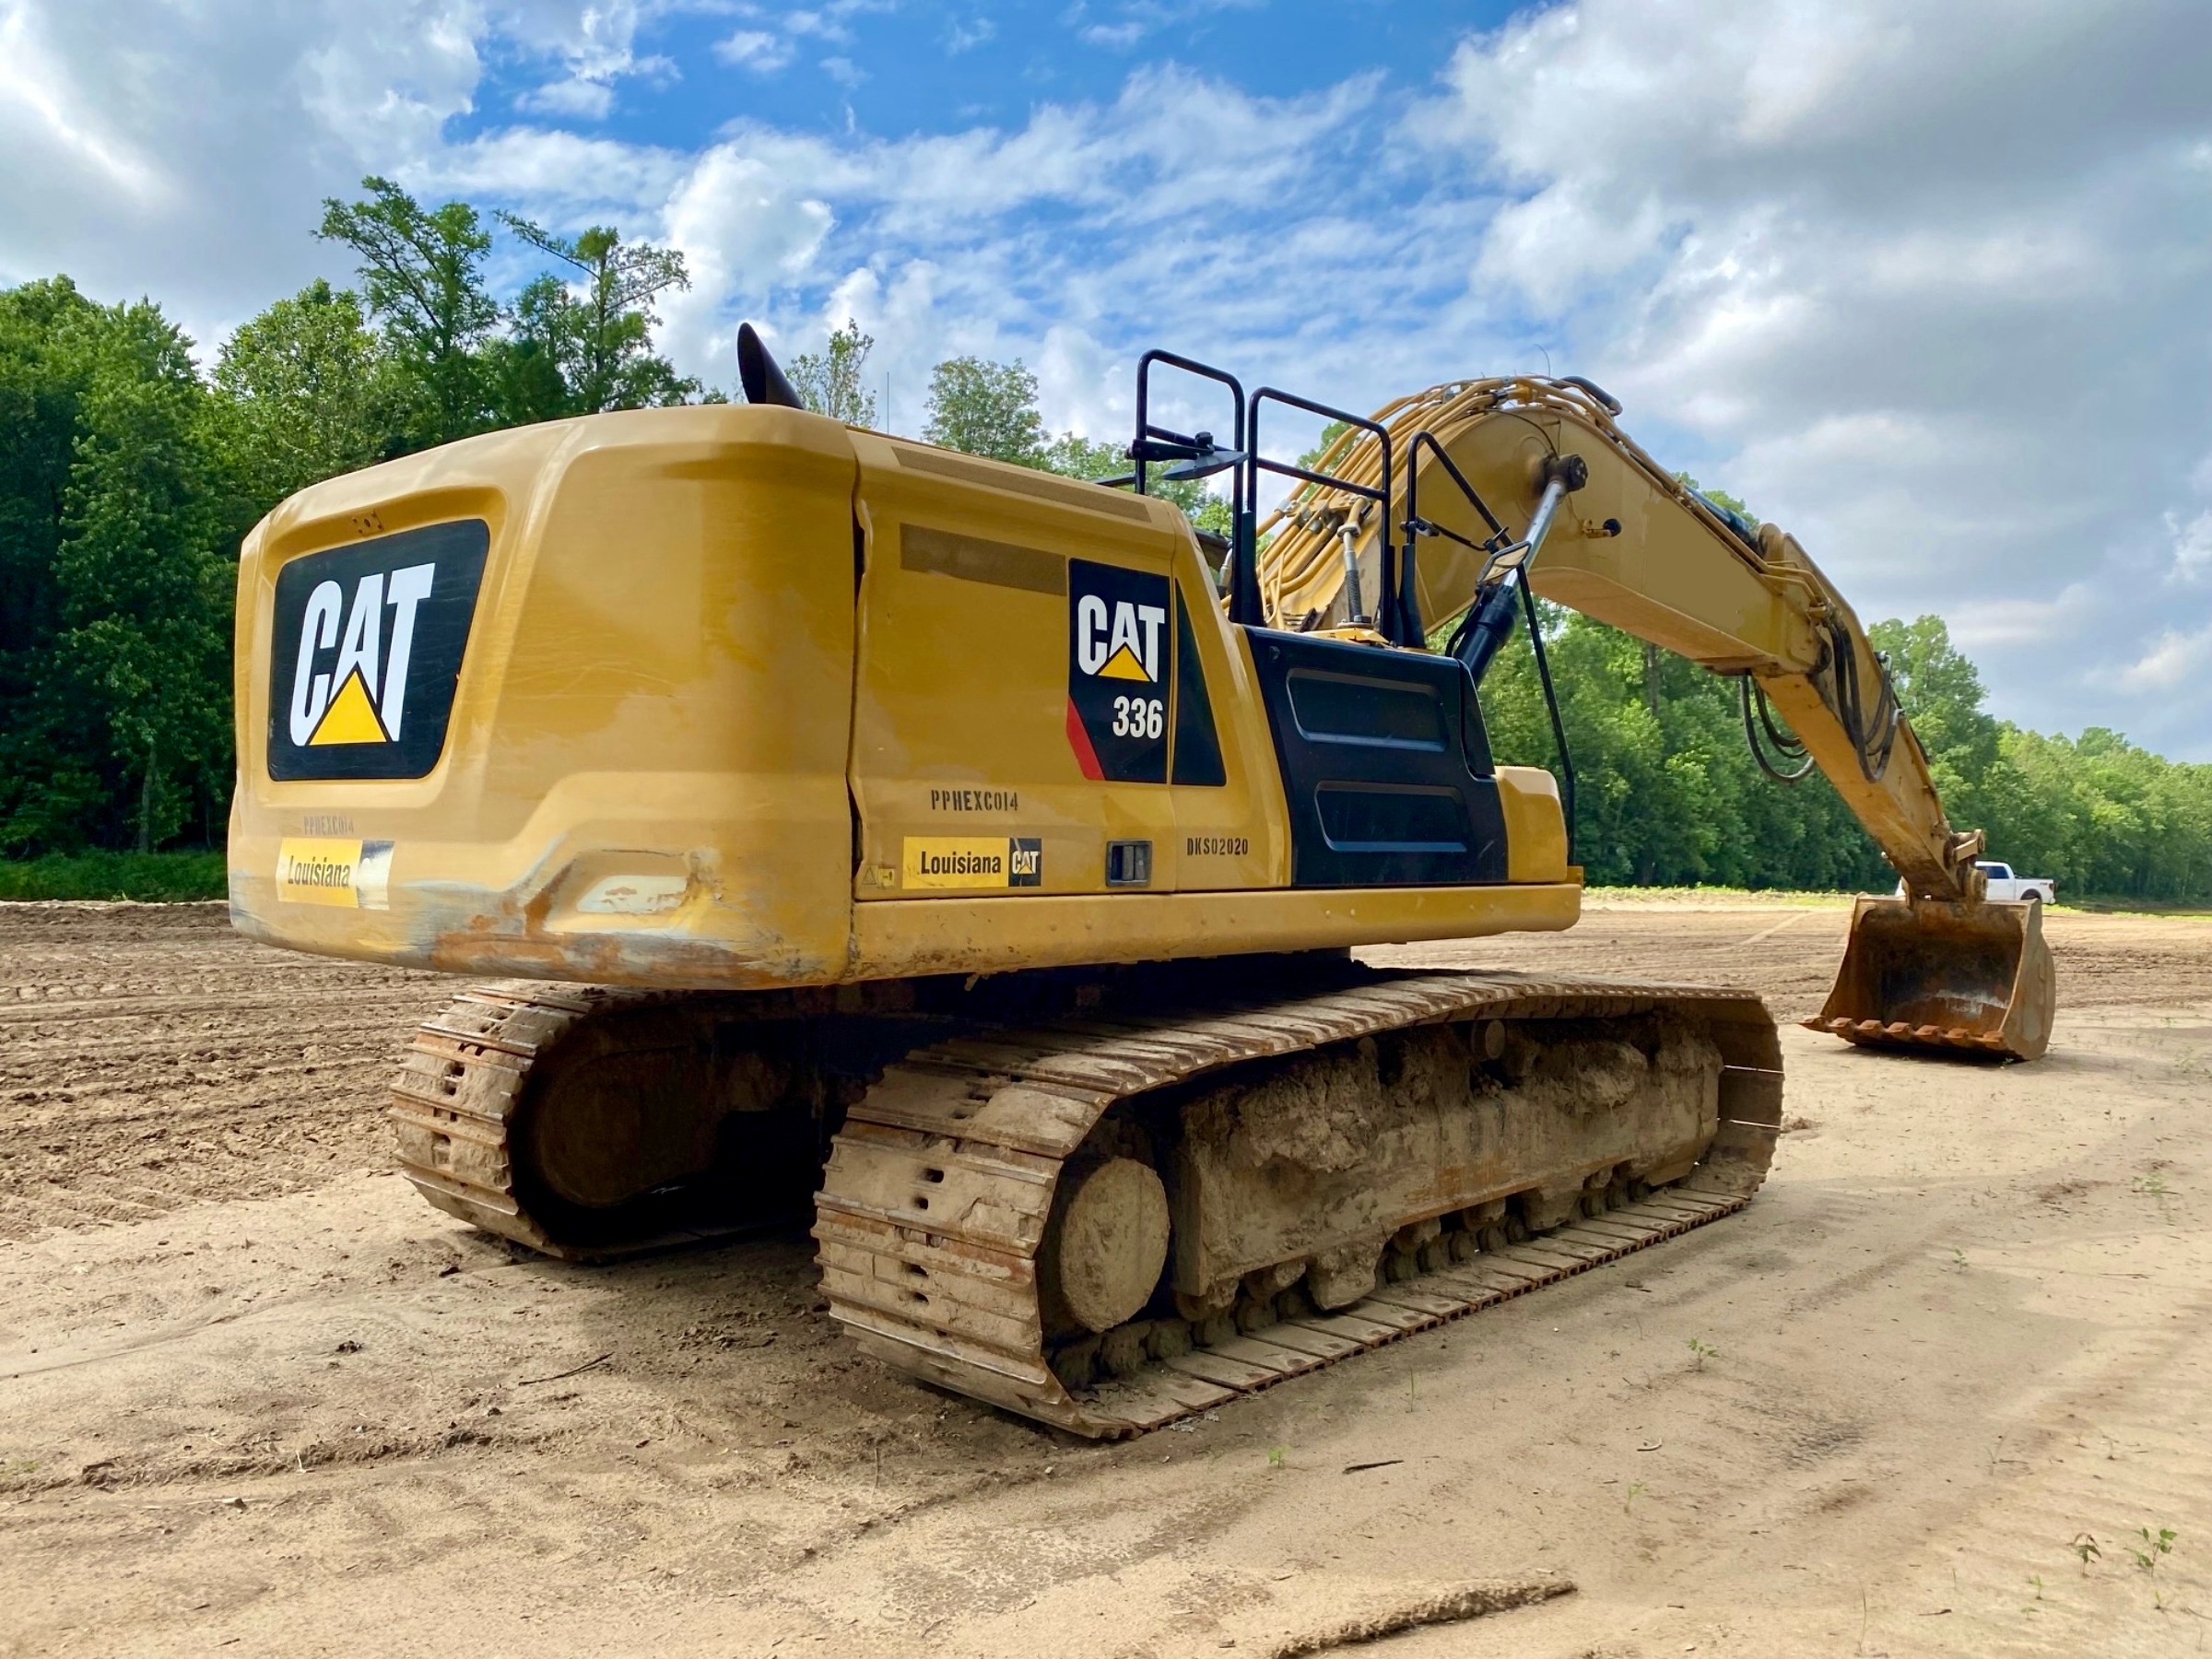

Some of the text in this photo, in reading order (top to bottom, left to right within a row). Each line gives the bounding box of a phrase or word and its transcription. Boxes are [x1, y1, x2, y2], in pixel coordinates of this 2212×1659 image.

[290, 563, 435, 746] CAT
[1078, 594, 1165, 683] CAT
[1112, 696, 1163, 738] 336
[922, 851, 1039, 875] Louisiana CAT
[1187, 837, 1248, 855] DKS02020
[288, 854, 350, 888] Louisiana
